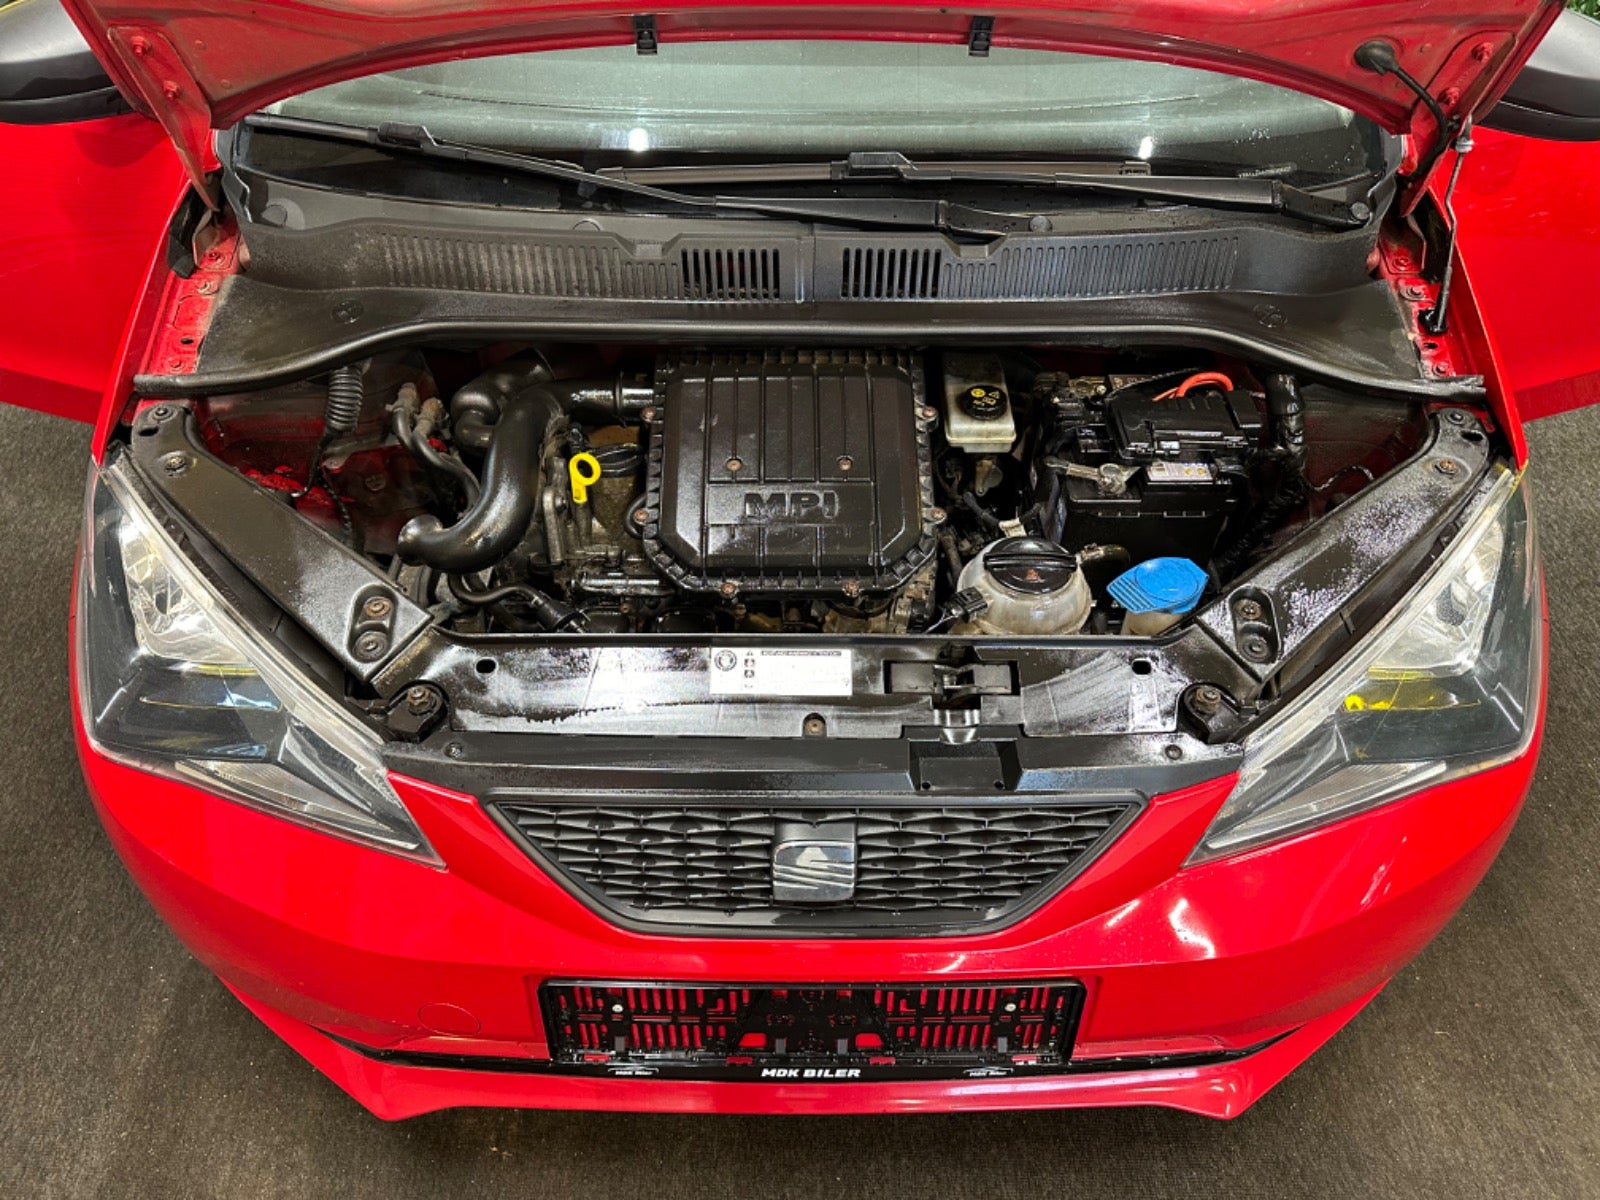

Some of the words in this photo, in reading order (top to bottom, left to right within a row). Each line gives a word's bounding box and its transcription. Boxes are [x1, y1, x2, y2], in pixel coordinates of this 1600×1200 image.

[743, 490, 839, 518] MPI
[761, 1068, 799, 1077] MDK
[803, 1068, 861, 1078] BILER
